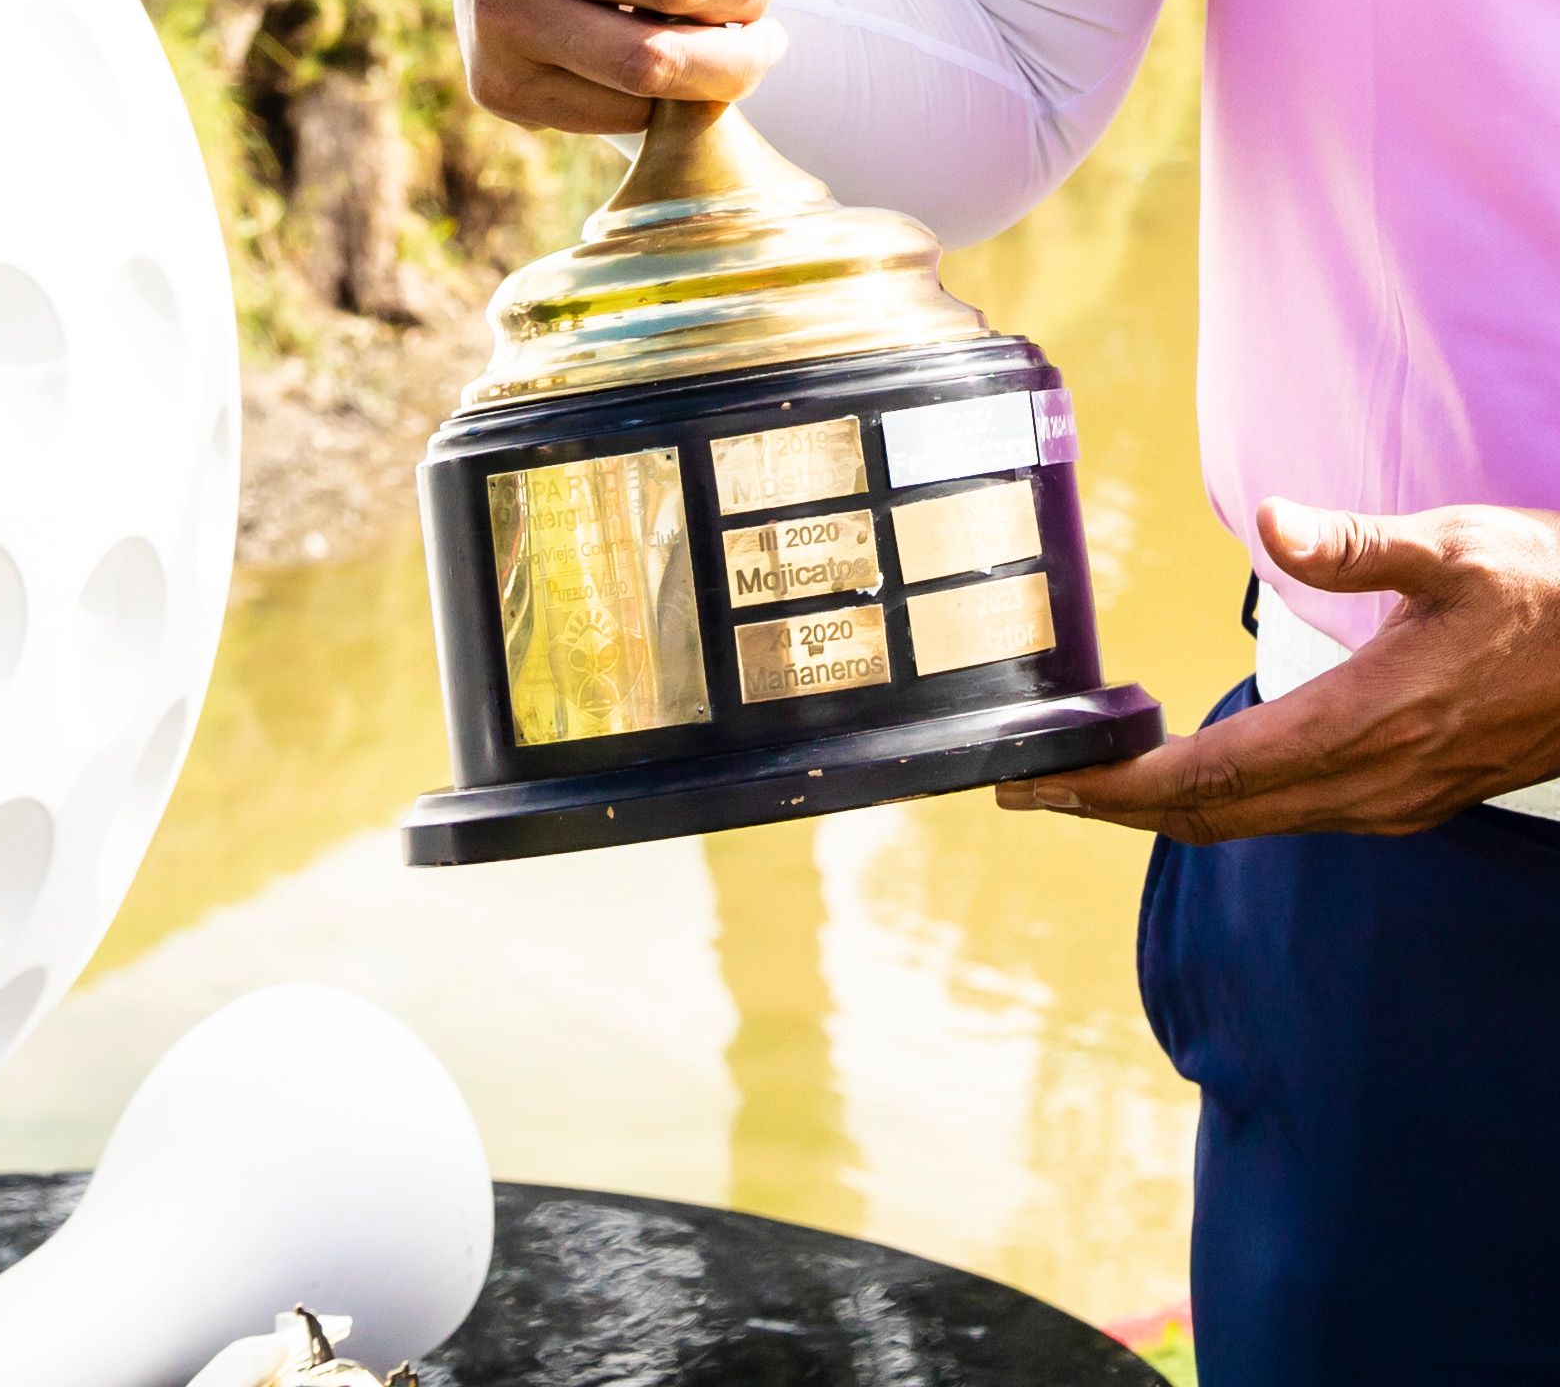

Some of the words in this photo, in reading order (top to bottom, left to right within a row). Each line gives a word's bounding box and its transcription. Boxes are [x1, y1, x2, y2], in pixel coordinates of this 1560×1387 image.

[758, 530, 777, 552] III
[785, 521, 840, 548] 2020
[542, 544, 576, 564] Viejo
[800, 620, 853, 646] 2020
[750, 655, 885, 693] Mañaneros
